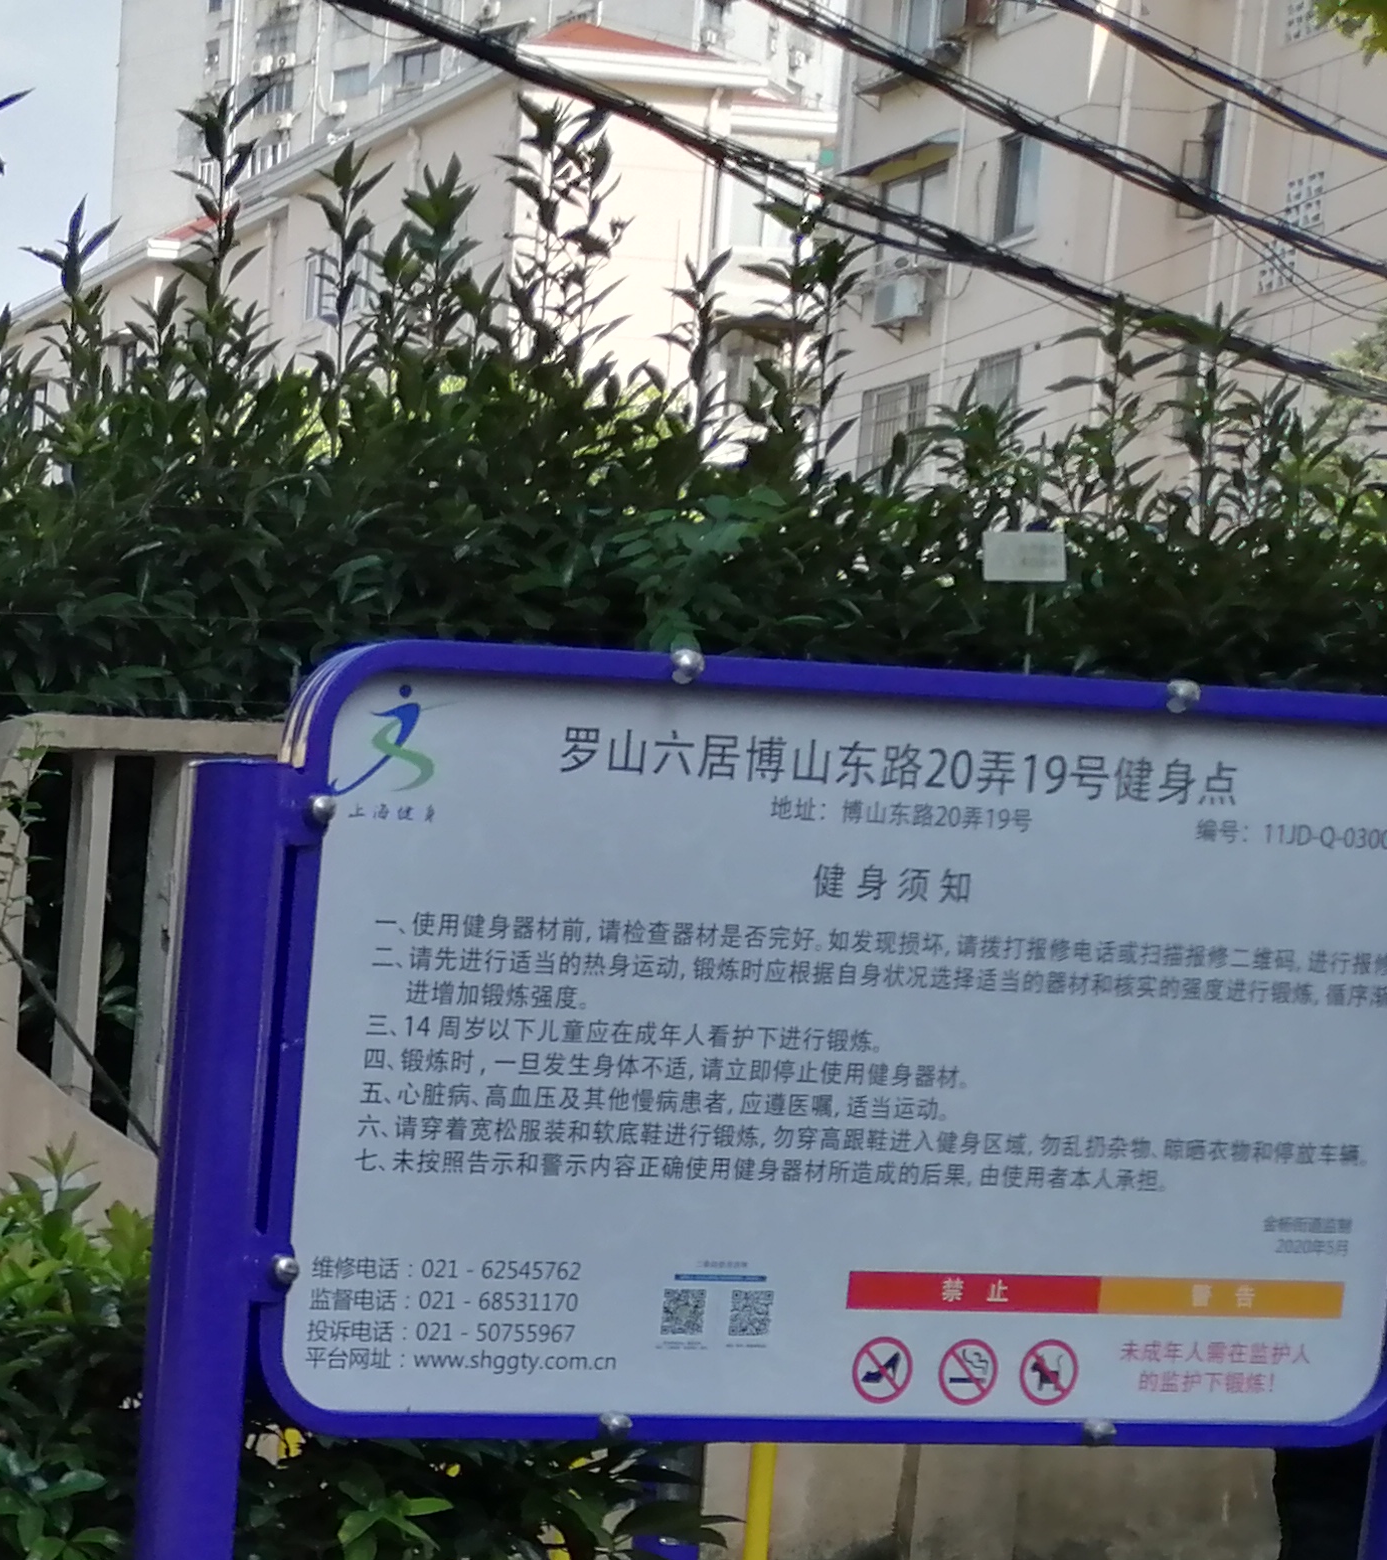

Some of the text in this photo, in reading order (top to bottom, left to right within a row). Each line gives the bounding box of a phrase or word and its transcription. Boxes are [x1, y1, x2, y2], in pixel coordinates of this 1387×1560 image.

[560, 726, 1238, 806] 罗山六居博山东路20弄19号健身点
[813, 862, 972, 904] 健身须知
[405, 979, 587, 1011] 进增加锻炼强度。
[941, 1277, 1009, 1303] 禁止
[1119, 1340, 1310, 1366] 未成年人需在监护人
